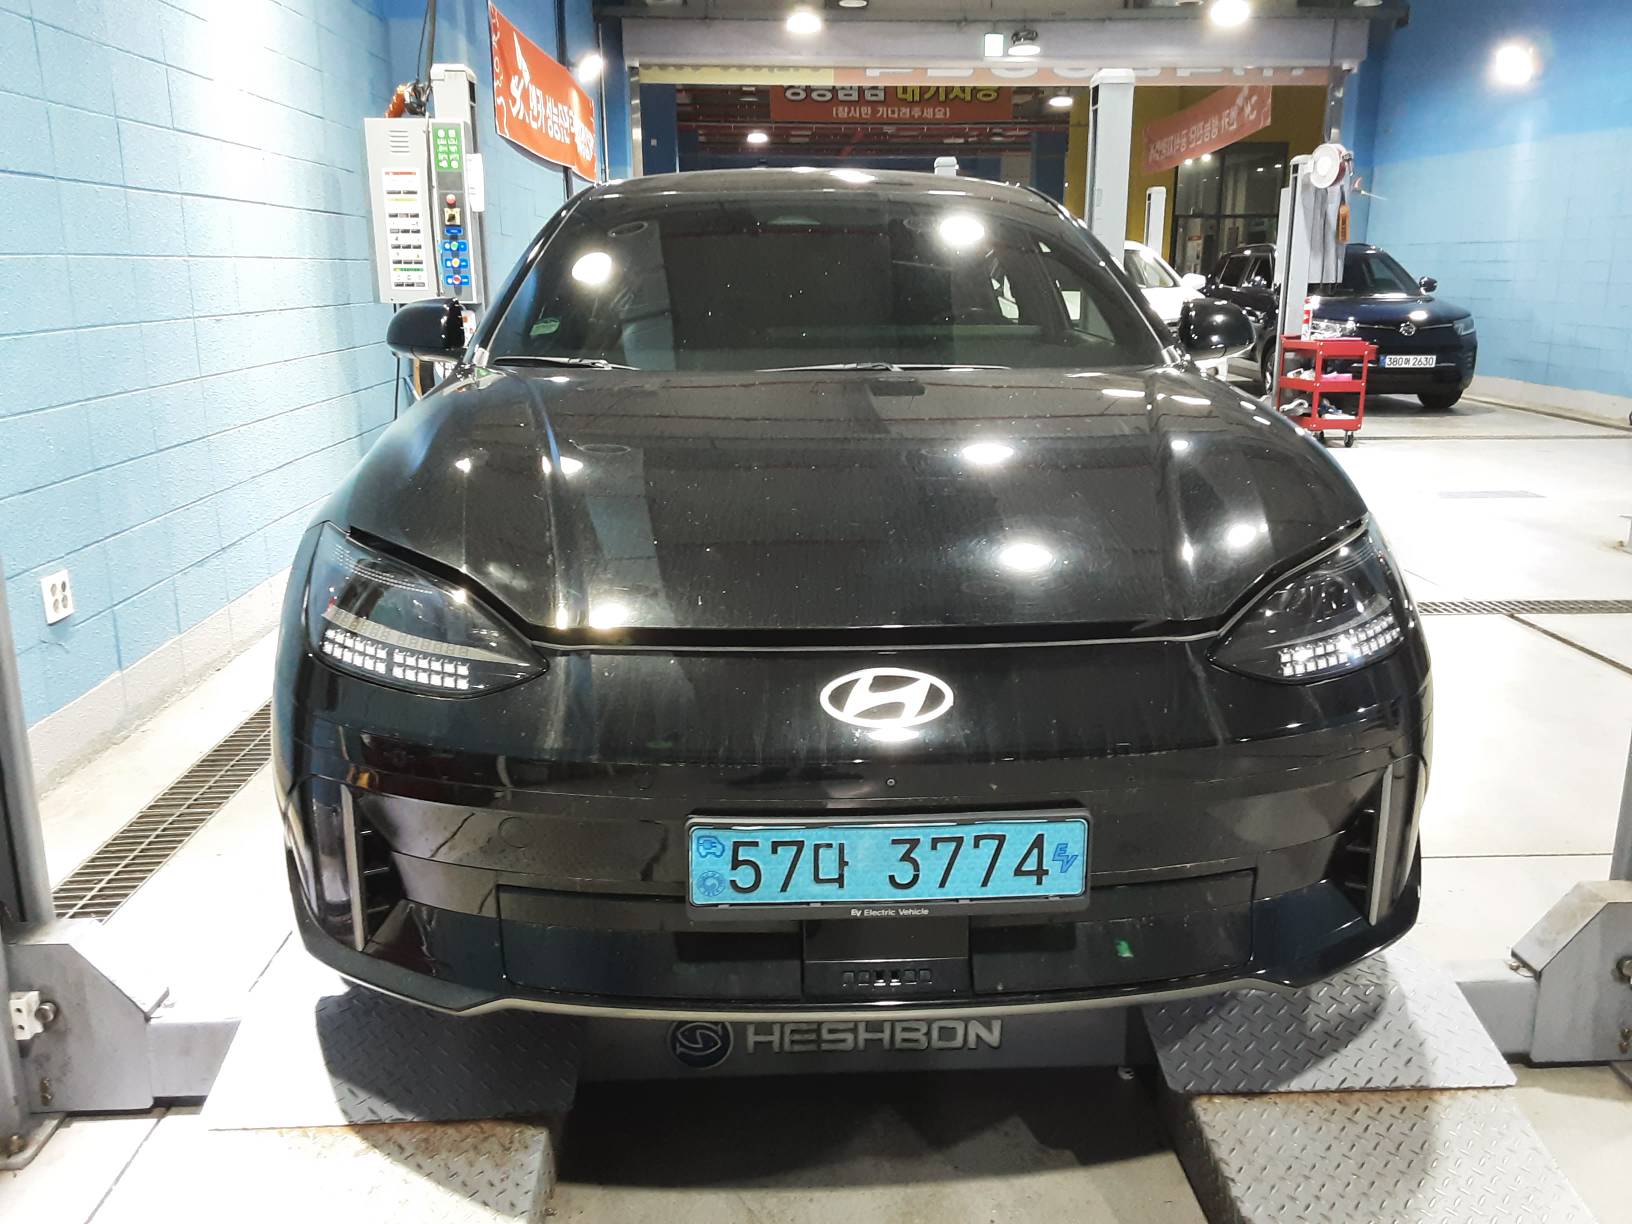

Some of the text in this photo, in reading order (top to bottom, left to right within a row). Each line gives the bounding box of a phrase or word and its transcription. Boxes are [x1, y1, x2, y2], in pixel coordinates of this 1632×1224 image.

[1412, 356, 1434, 367] 2630
[729, 839, 849, 894] 57다
[887, 832, 1050, 891] 3774
[864, 908, 896, 917] Electric
[898, 907, 929, 916] Vehicle
[746, 1019, 1002, 1054] HESHBON
